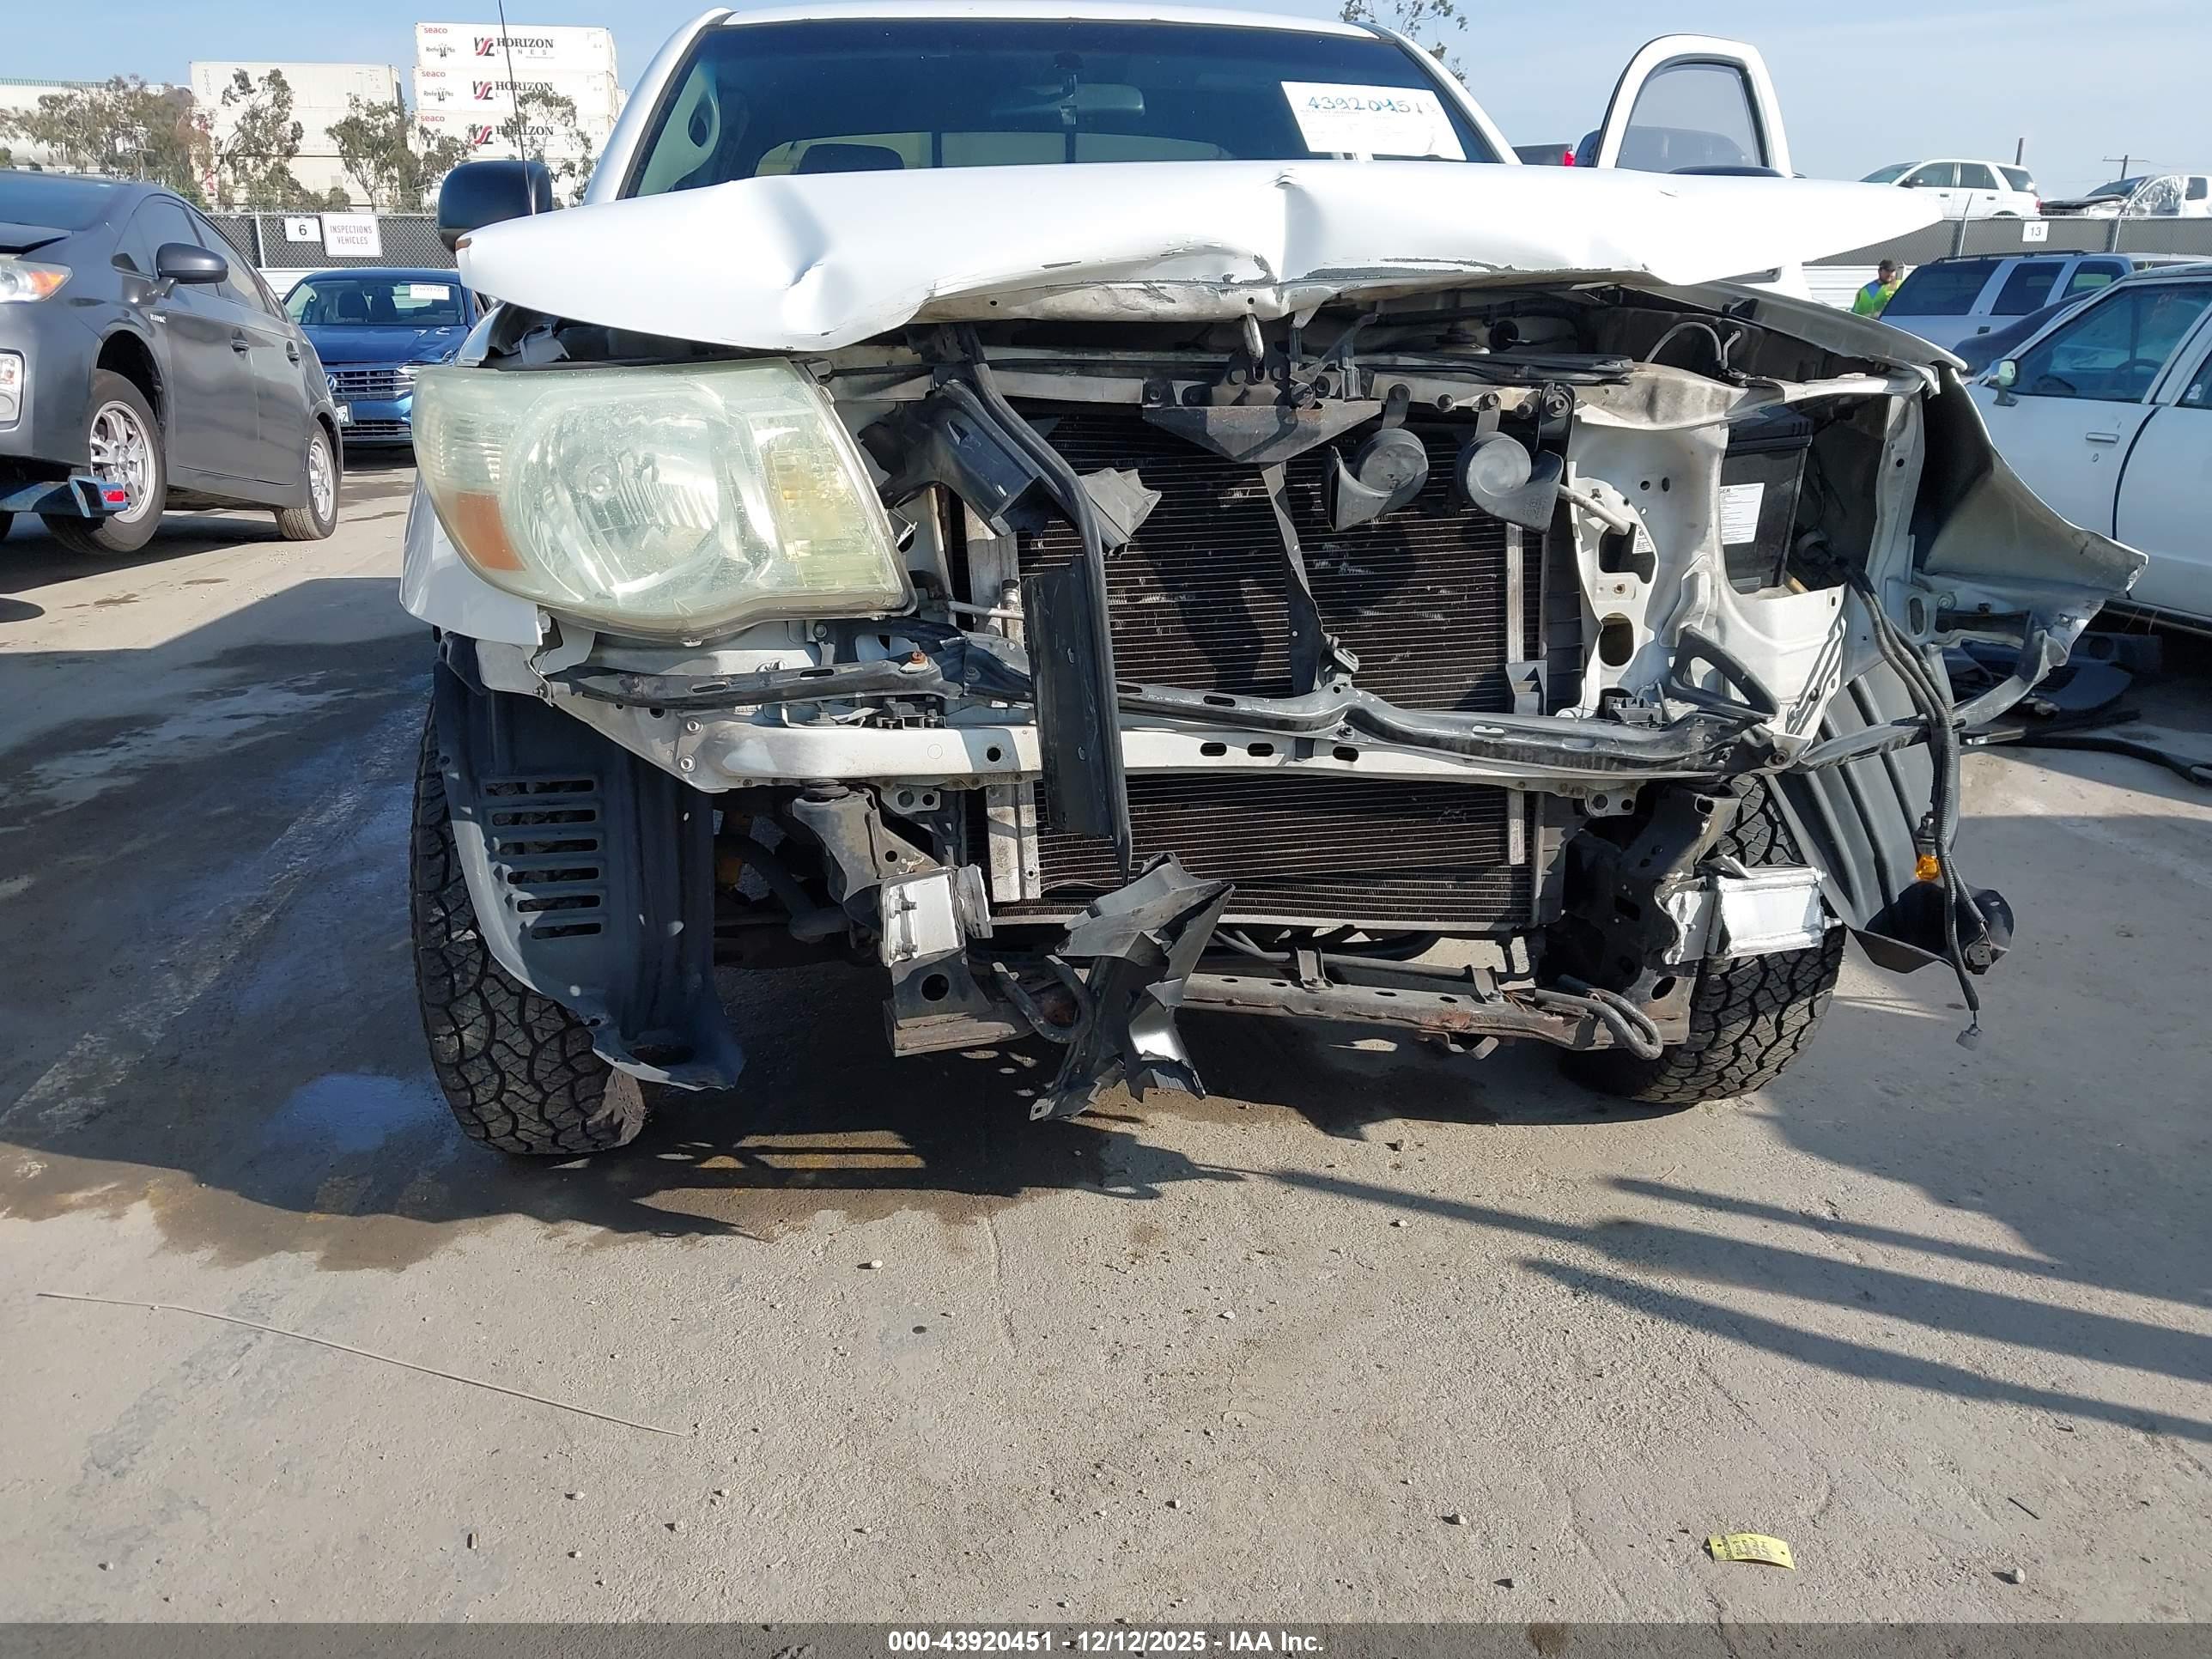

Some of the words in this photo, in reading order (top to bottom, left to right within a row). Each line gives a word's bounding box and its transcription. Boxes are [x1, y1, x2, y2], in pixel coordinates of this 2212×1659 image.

[496, 37, 554, 48] HORIZON
[495, 81, 553, 91] HORIZON
[299, 224, 307, 235] 6
[330, 225, 372, 234] INSPECTIONS
[2031, 226, 2042, 236] 13
[337, 236, 368, 245] VEHICLES
